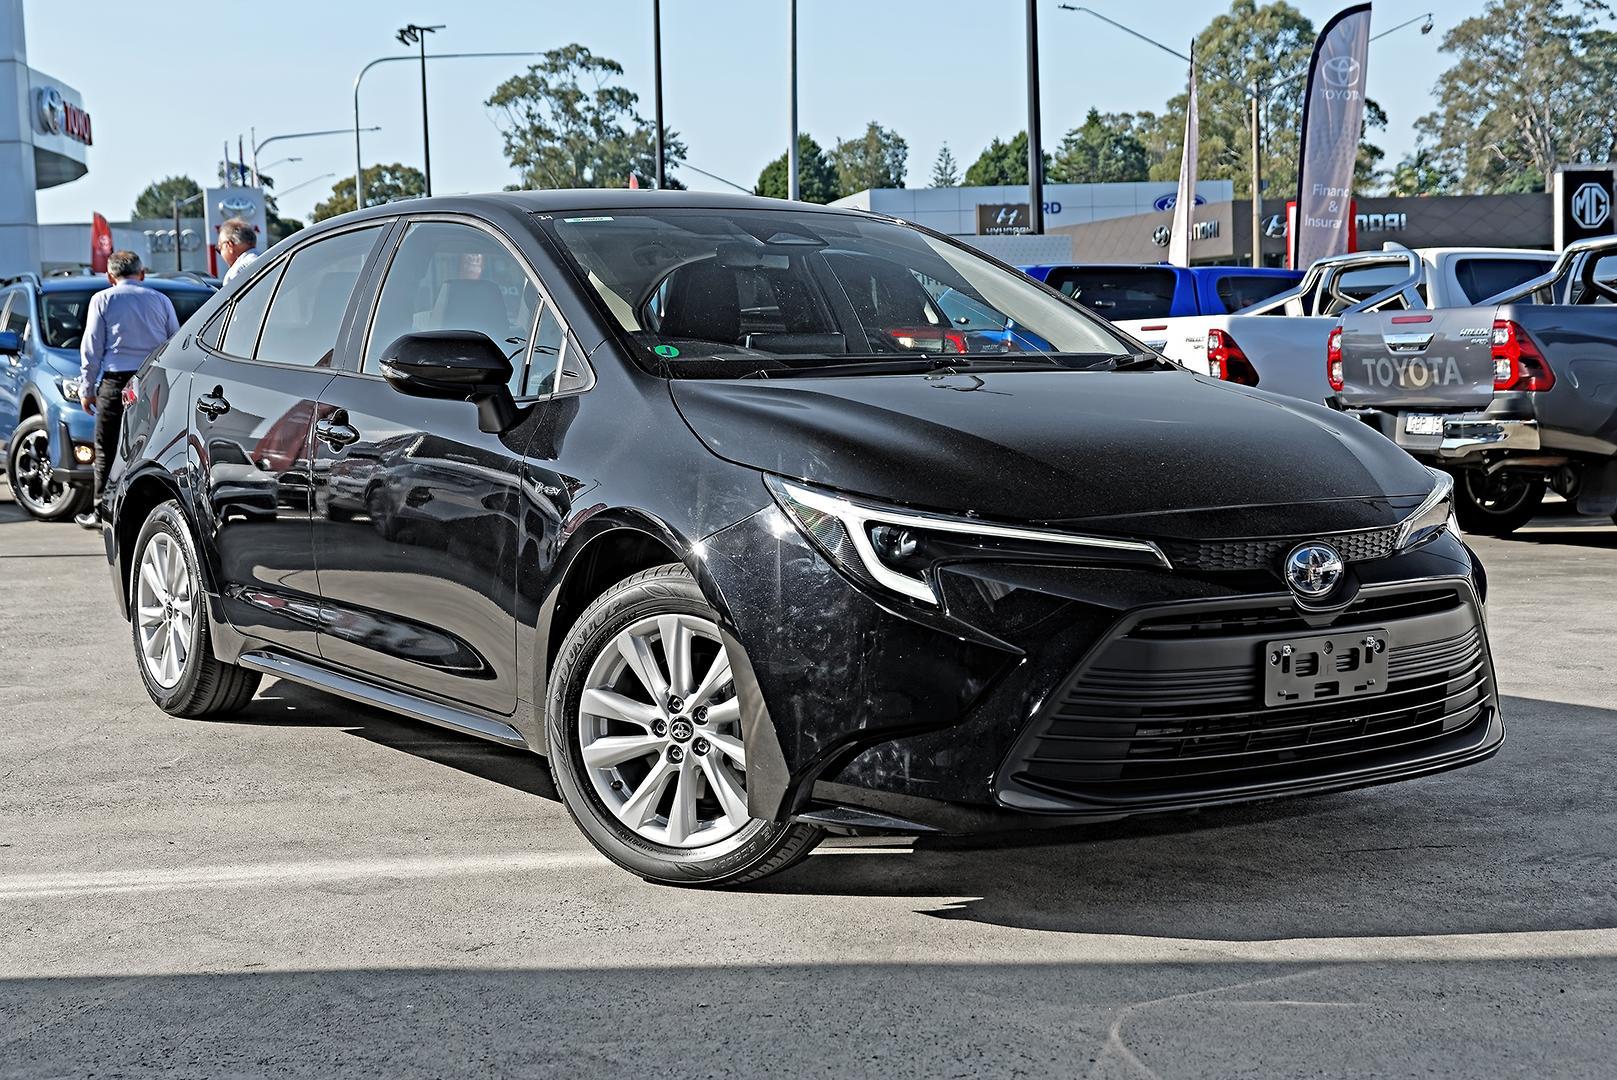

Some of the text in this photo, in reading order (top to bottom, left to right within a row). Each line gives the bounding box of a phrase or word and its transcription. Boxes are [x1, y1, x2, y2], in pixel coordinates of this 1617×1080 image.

[1312, 184, 1349, 197] Financ
[1043, 201, 1062, 215] RD
[1328, 200, 1338, 212] &
[1575, 187, 1606, 224] MG
[1192, 220, 1219, 240] NDAI
[1304, 214, 1342, 229] Insura
[1355, 213, 1407, 231] NDAI
[1361, 356, 1464, 388] TOYOTA
[559, 600, 622, 684] DUNLOP
